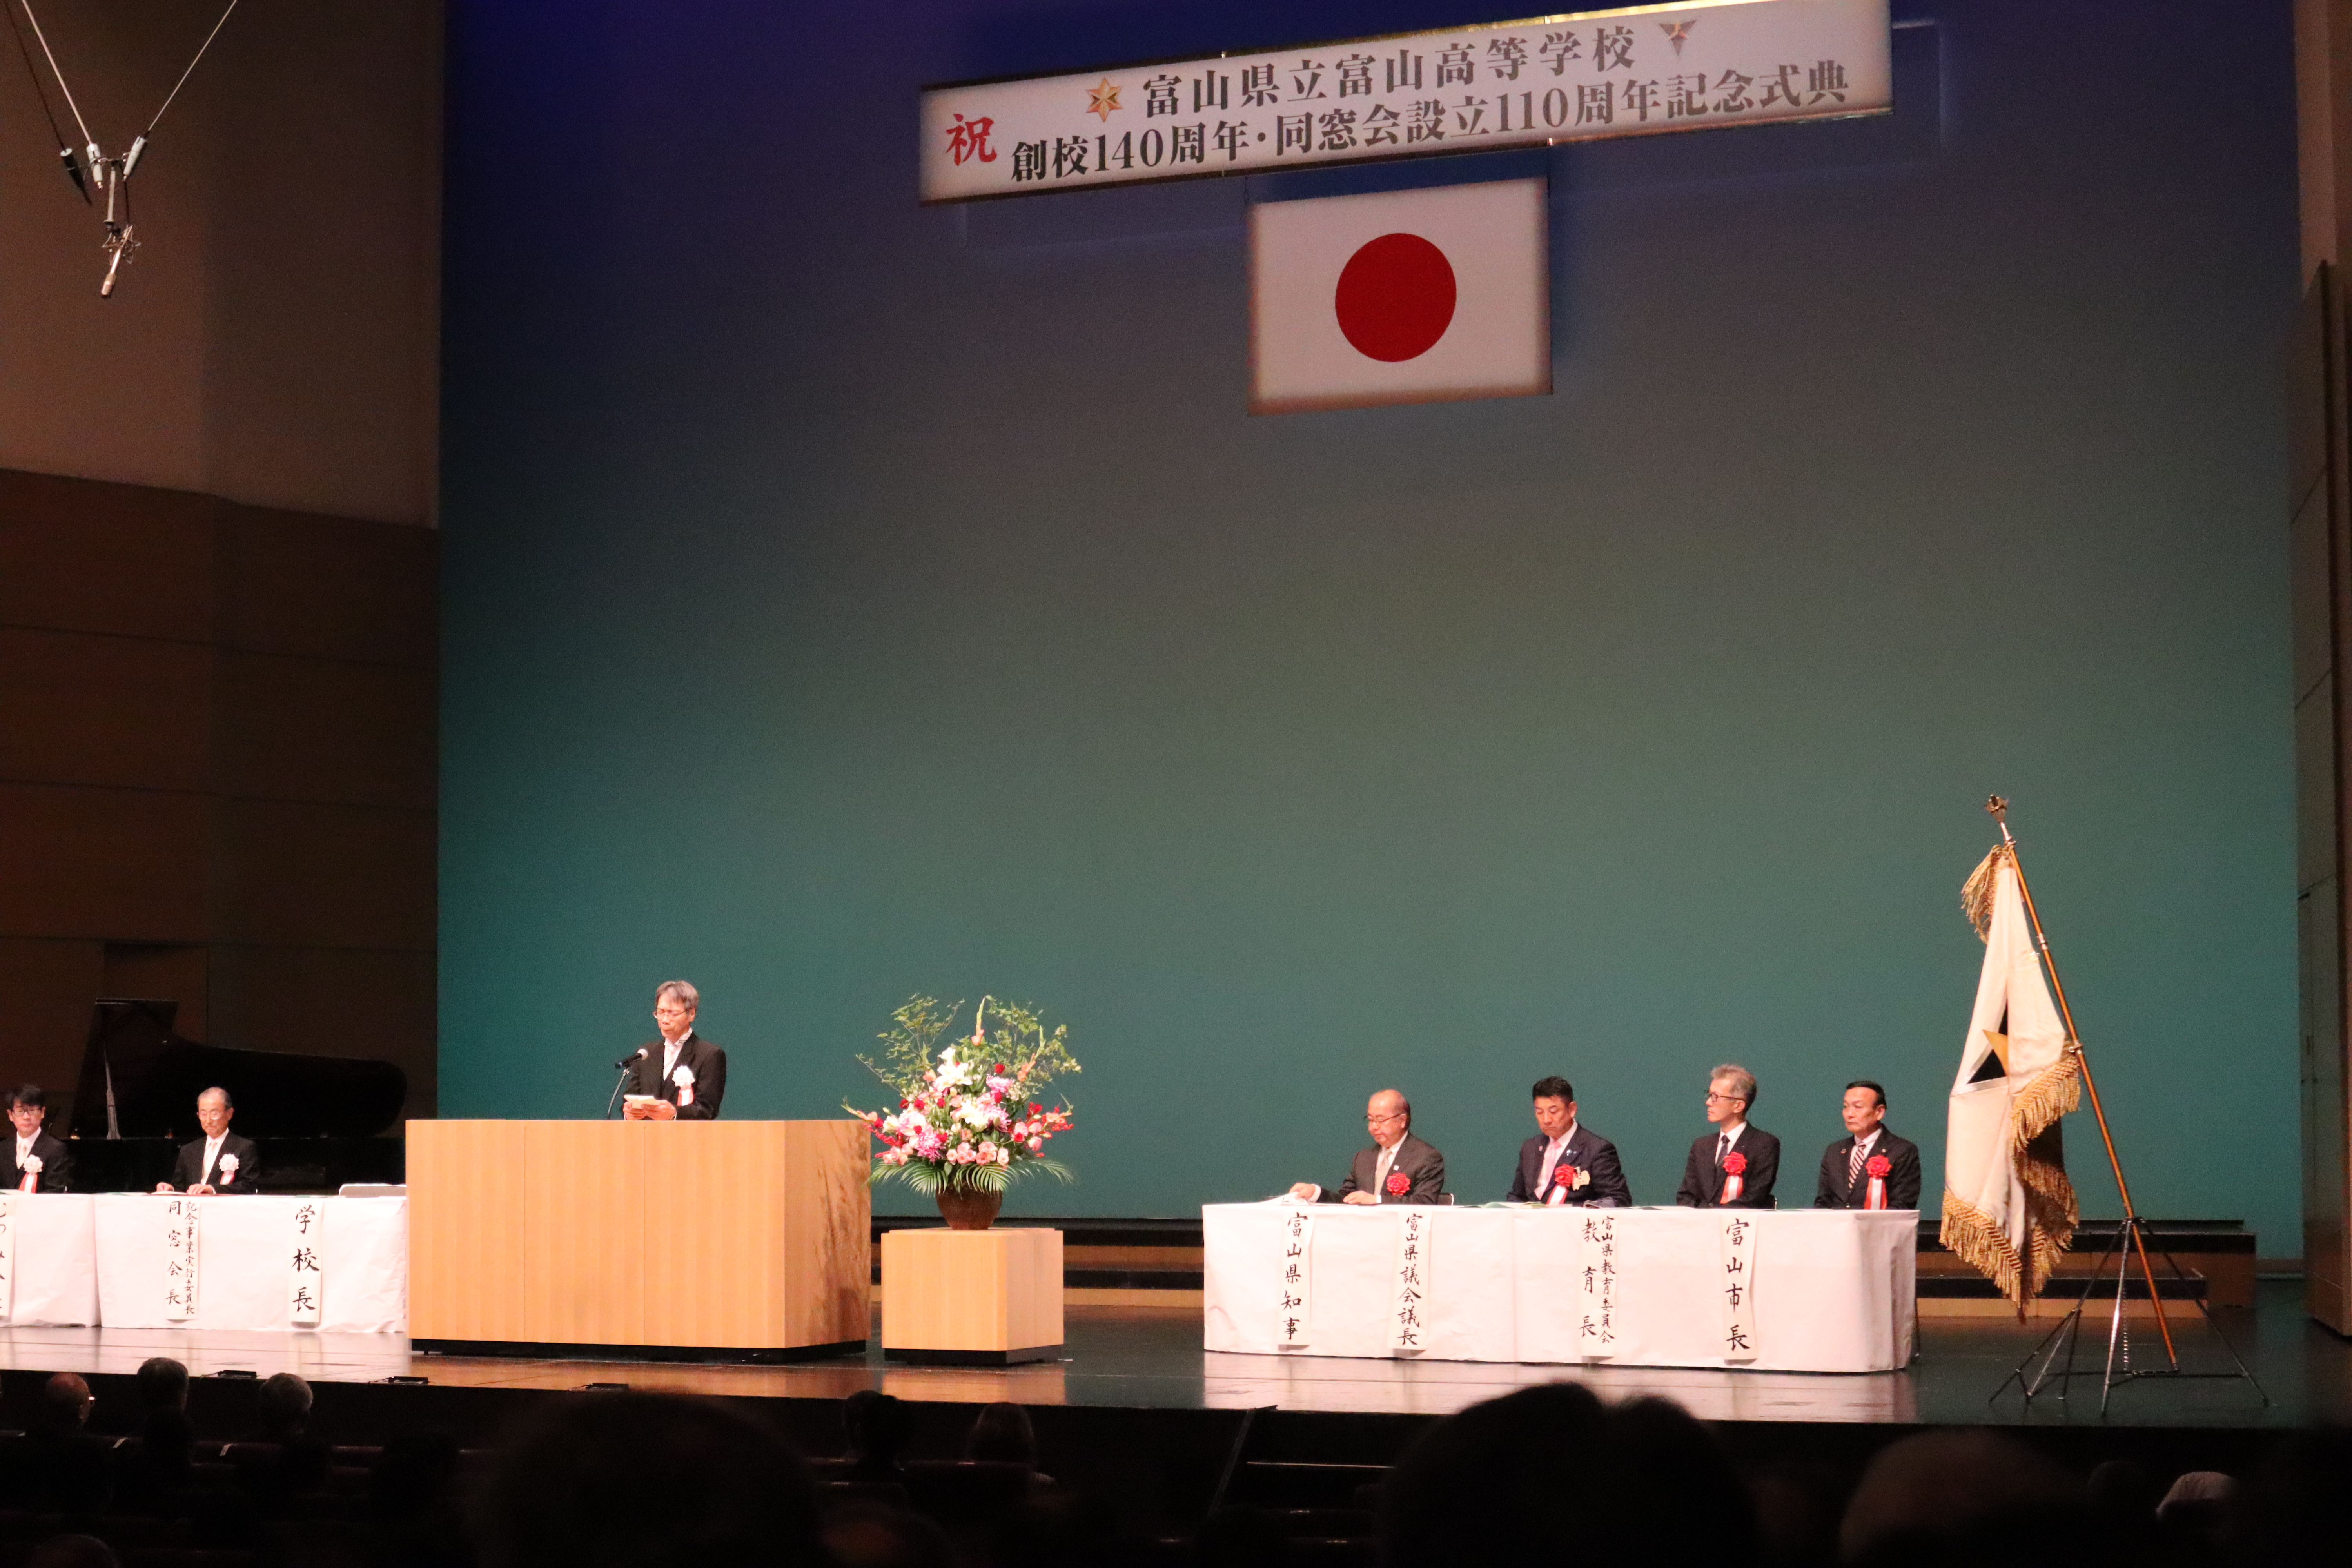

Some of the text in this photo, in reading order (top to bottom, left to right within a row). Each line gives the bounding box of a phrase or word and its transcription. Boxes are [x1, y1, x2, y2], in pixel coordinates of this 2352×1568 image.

[1143, 26, 1634, 118] 富山県立富山高等学校
[946, 113, 997, 166] 祝
[166, 1201, 182, 1305] 同窓会長
[292, 1205, 319, 1312] 学校長
[1281, 1212, 1308, 1340] 富山県知事
[1397, 1213, 1422, 1346] 富山県議会議長
[1579, 1218, 1600, 1337] 教育長
[1599, 1216, 1615, 1343] 富山県教育委員会
[1726, 1218, 1750, 1351] 富山市長
